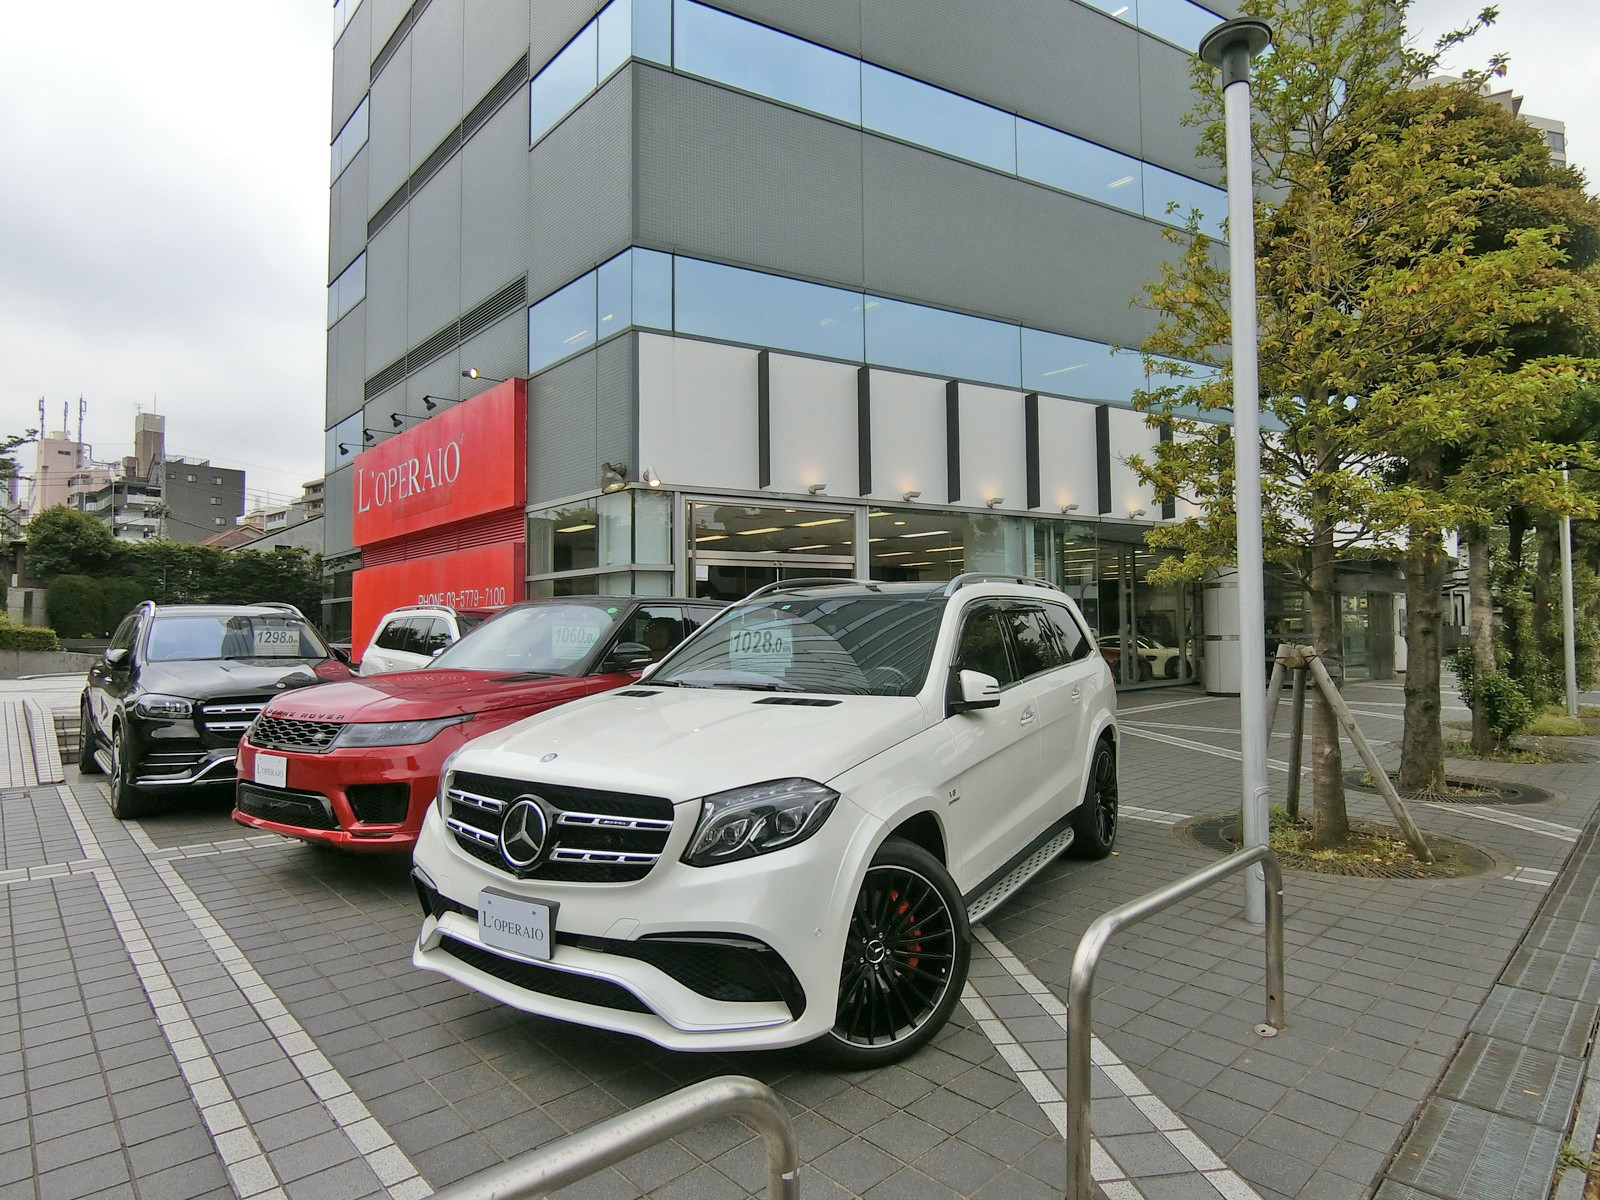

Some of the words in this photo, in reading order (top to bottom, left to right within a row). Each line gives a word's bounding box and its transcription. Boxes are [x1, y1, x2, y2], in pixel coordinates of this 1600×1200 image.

[358, 441, 461, 514] L'OPERAIO
[446, 586, 506, 608] 03-5779-7100
[257, 631, 294, 644] 1298.0
[734, 630, 783, 653] 1028.0
[482, 910, 544, 941] L'OPERAIO
